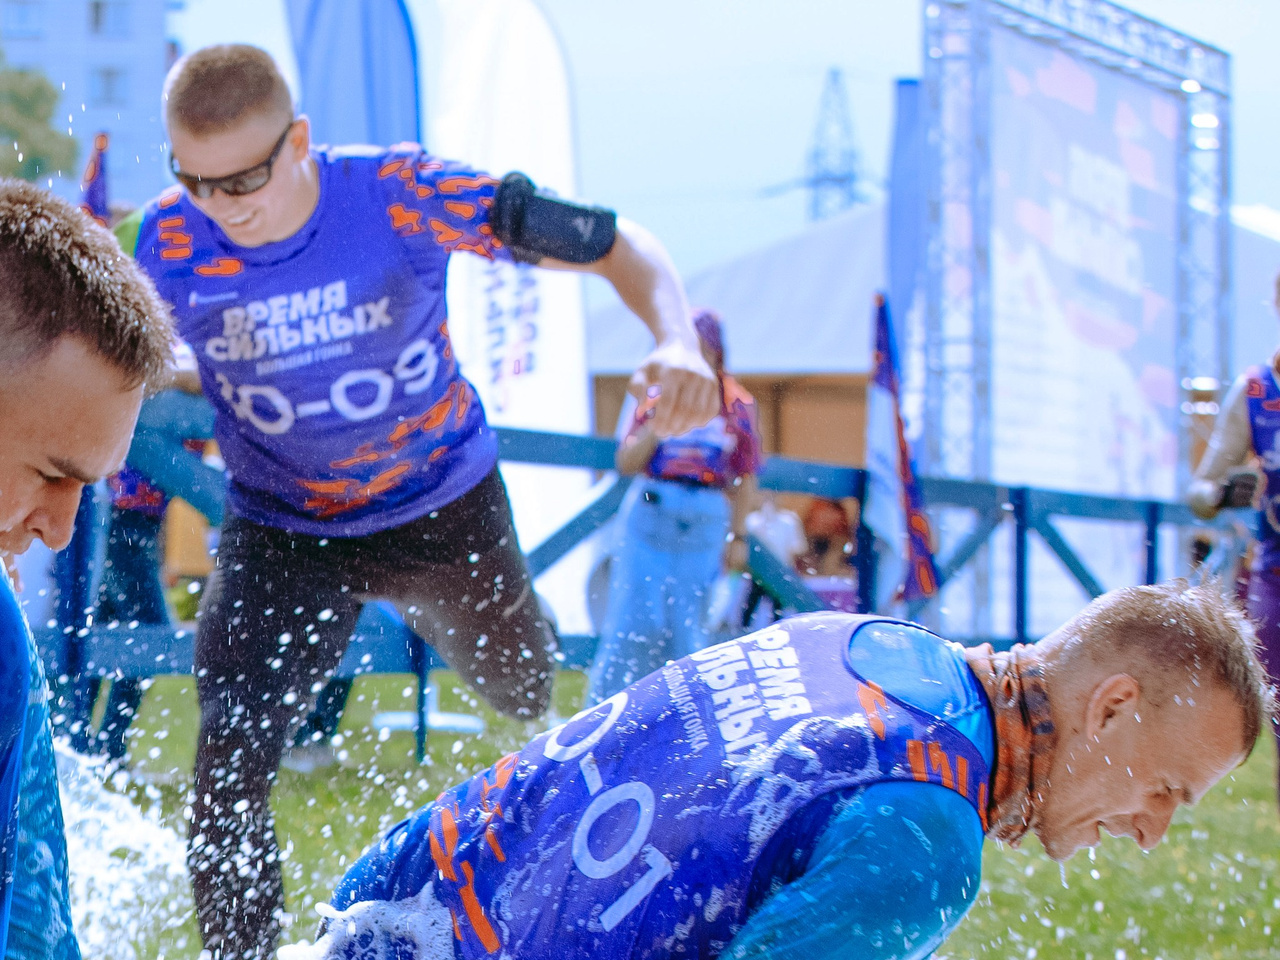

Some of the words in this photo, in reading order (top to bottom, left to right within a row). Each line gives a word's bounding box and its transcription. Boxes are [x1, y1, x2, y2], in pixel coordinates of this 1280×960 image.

[205, 296, 394, 362] СИЛЬНЫХ
[222, 279, 348, 337] ВРЕМЯ
[739, 623, 814, 722] РЕМЯ
